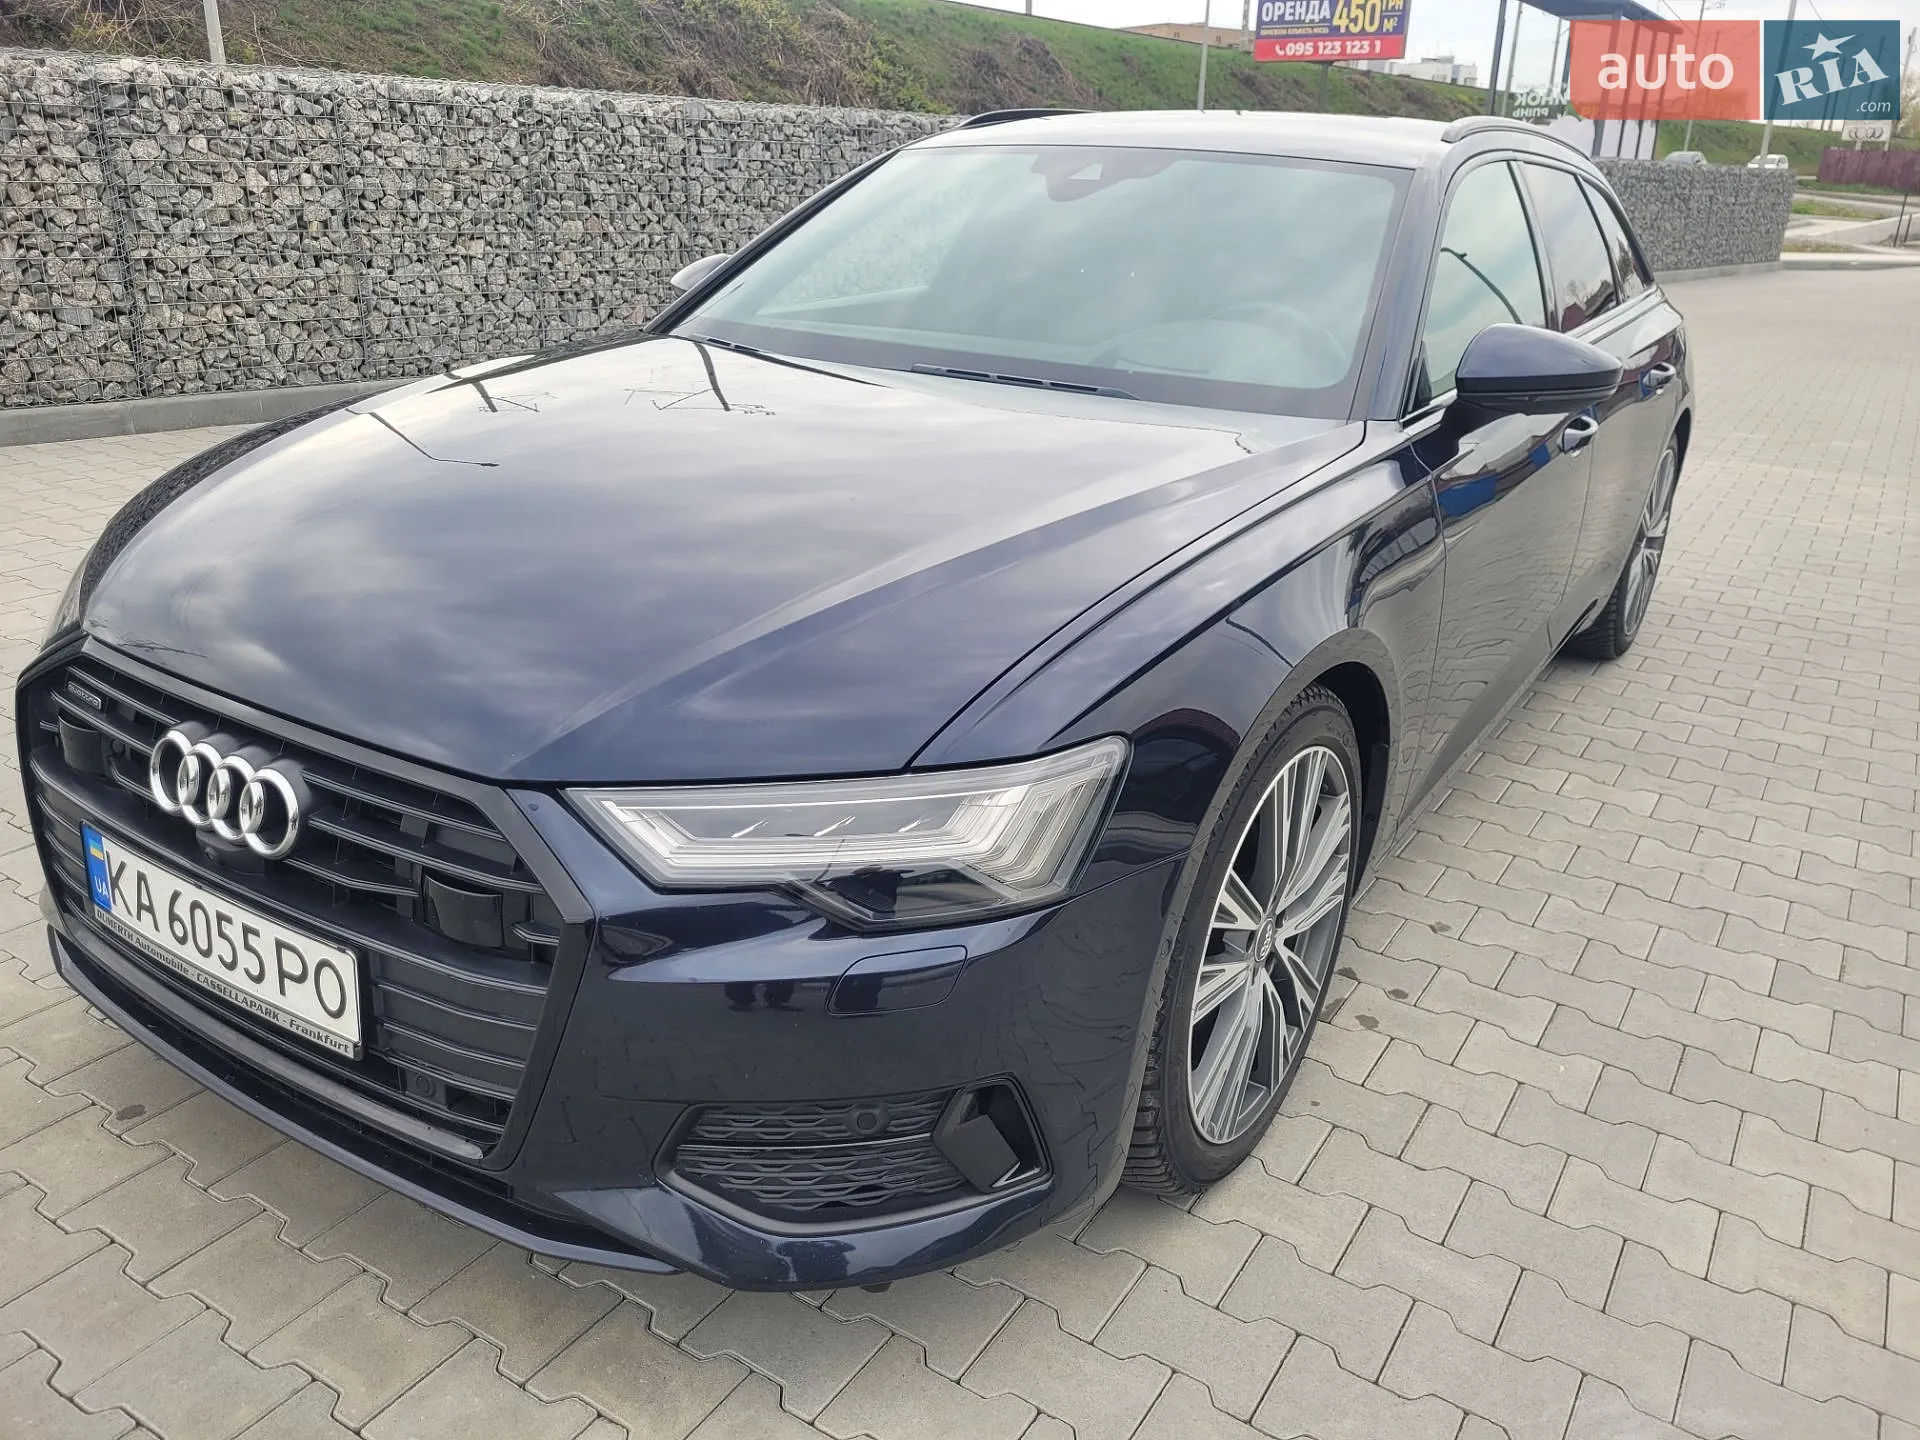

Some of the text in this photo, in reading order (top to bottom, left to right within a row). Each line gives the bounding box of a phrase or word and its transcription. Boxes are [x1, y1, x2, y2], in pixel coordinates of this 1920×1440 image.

[1261, 0, 1331, 22] ОРЕНДА
[1332, 0, 1381, 33] 450
[1285, 40, 1381, 56] 095 123 123 1
[95, 878, 110, 898] UA
[105, 850, 347, 1020] KA 6055 PO
[135, 936, 189, 974] Automobile
[196, 972, 280, 1022] CASSELLAPARK
[289, 1018, 350, 1053] Frankfurt
